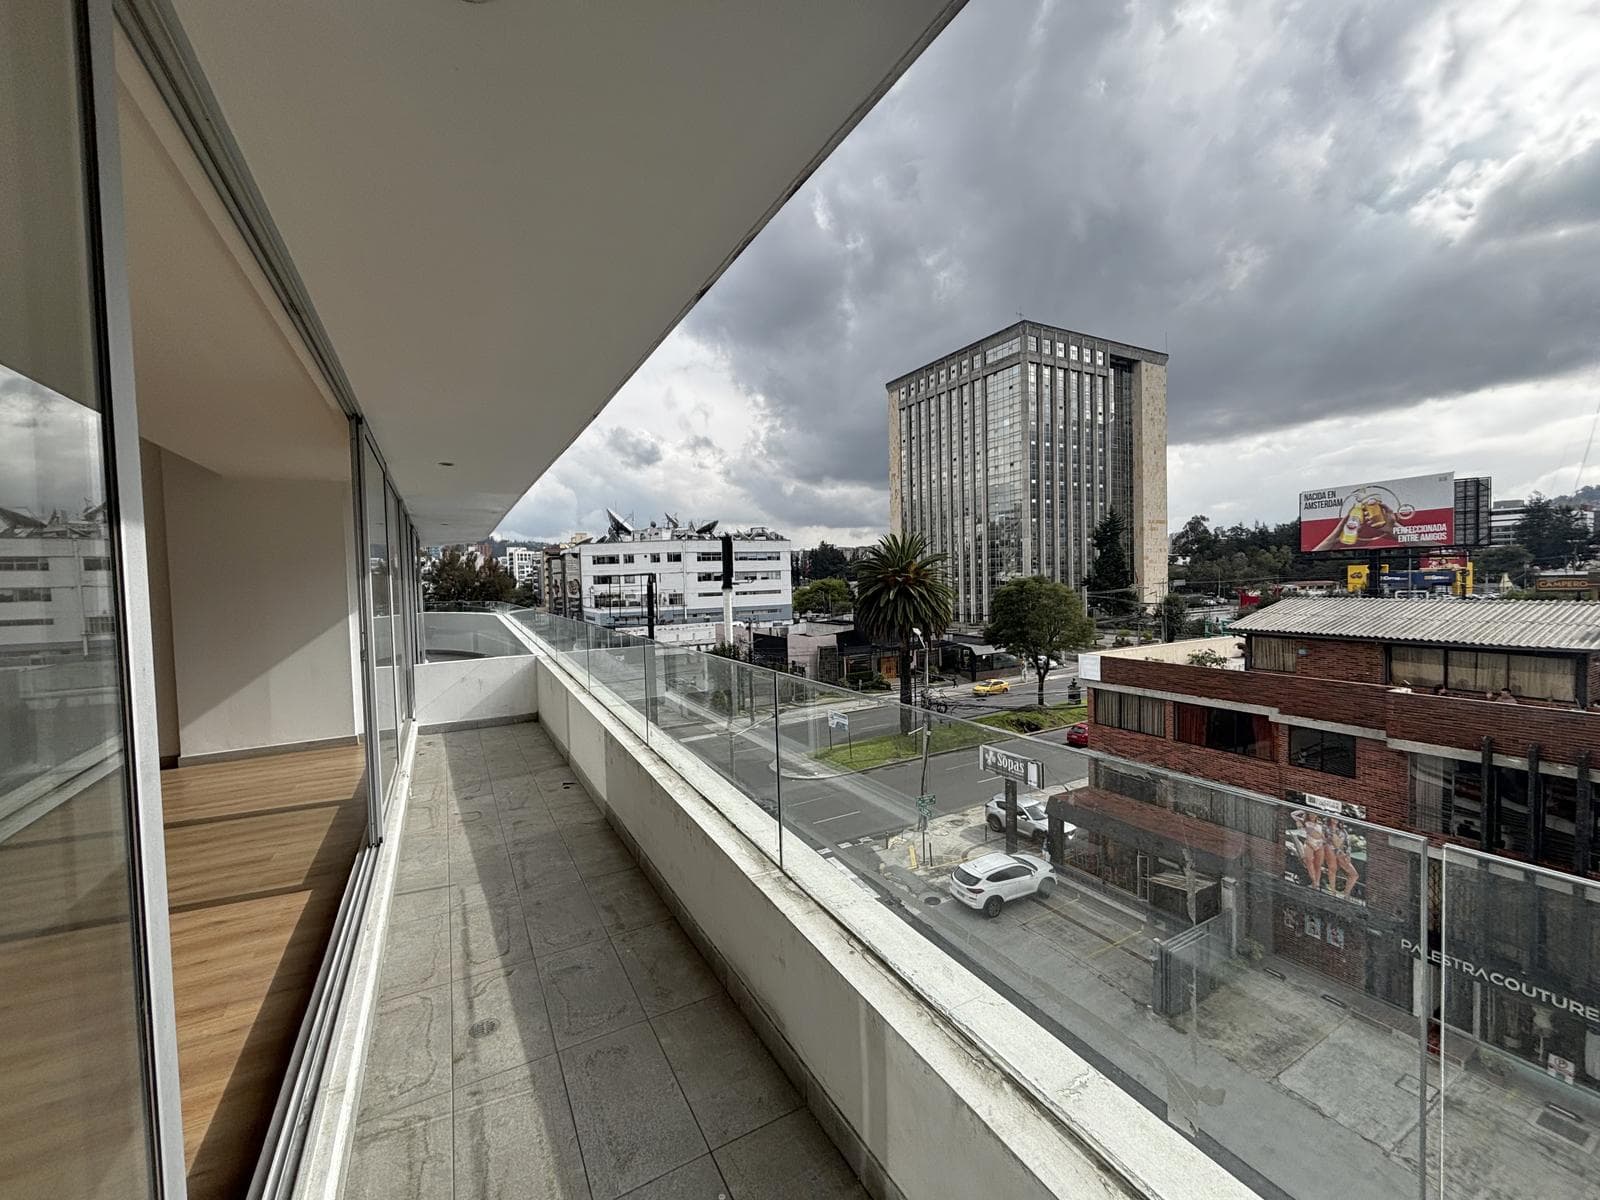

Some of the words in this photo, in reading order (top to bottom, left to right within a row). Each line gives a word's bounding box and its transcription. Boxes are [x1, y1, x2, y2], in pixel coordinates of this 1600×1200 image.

[1304, 491, 1327, 502] NACIDA
[1328, 490, 1336, 499] EN
[1304, 498, 1343, 510] AMSTERDAM
[1393, 523, 1447, 535] PERFECCIONADA
[1398, 532, 1420, 542] ENTRE
[1420, 532, 1447, 541] AMIGOS
[1539, 580, 1588, 588] CAMPERO
